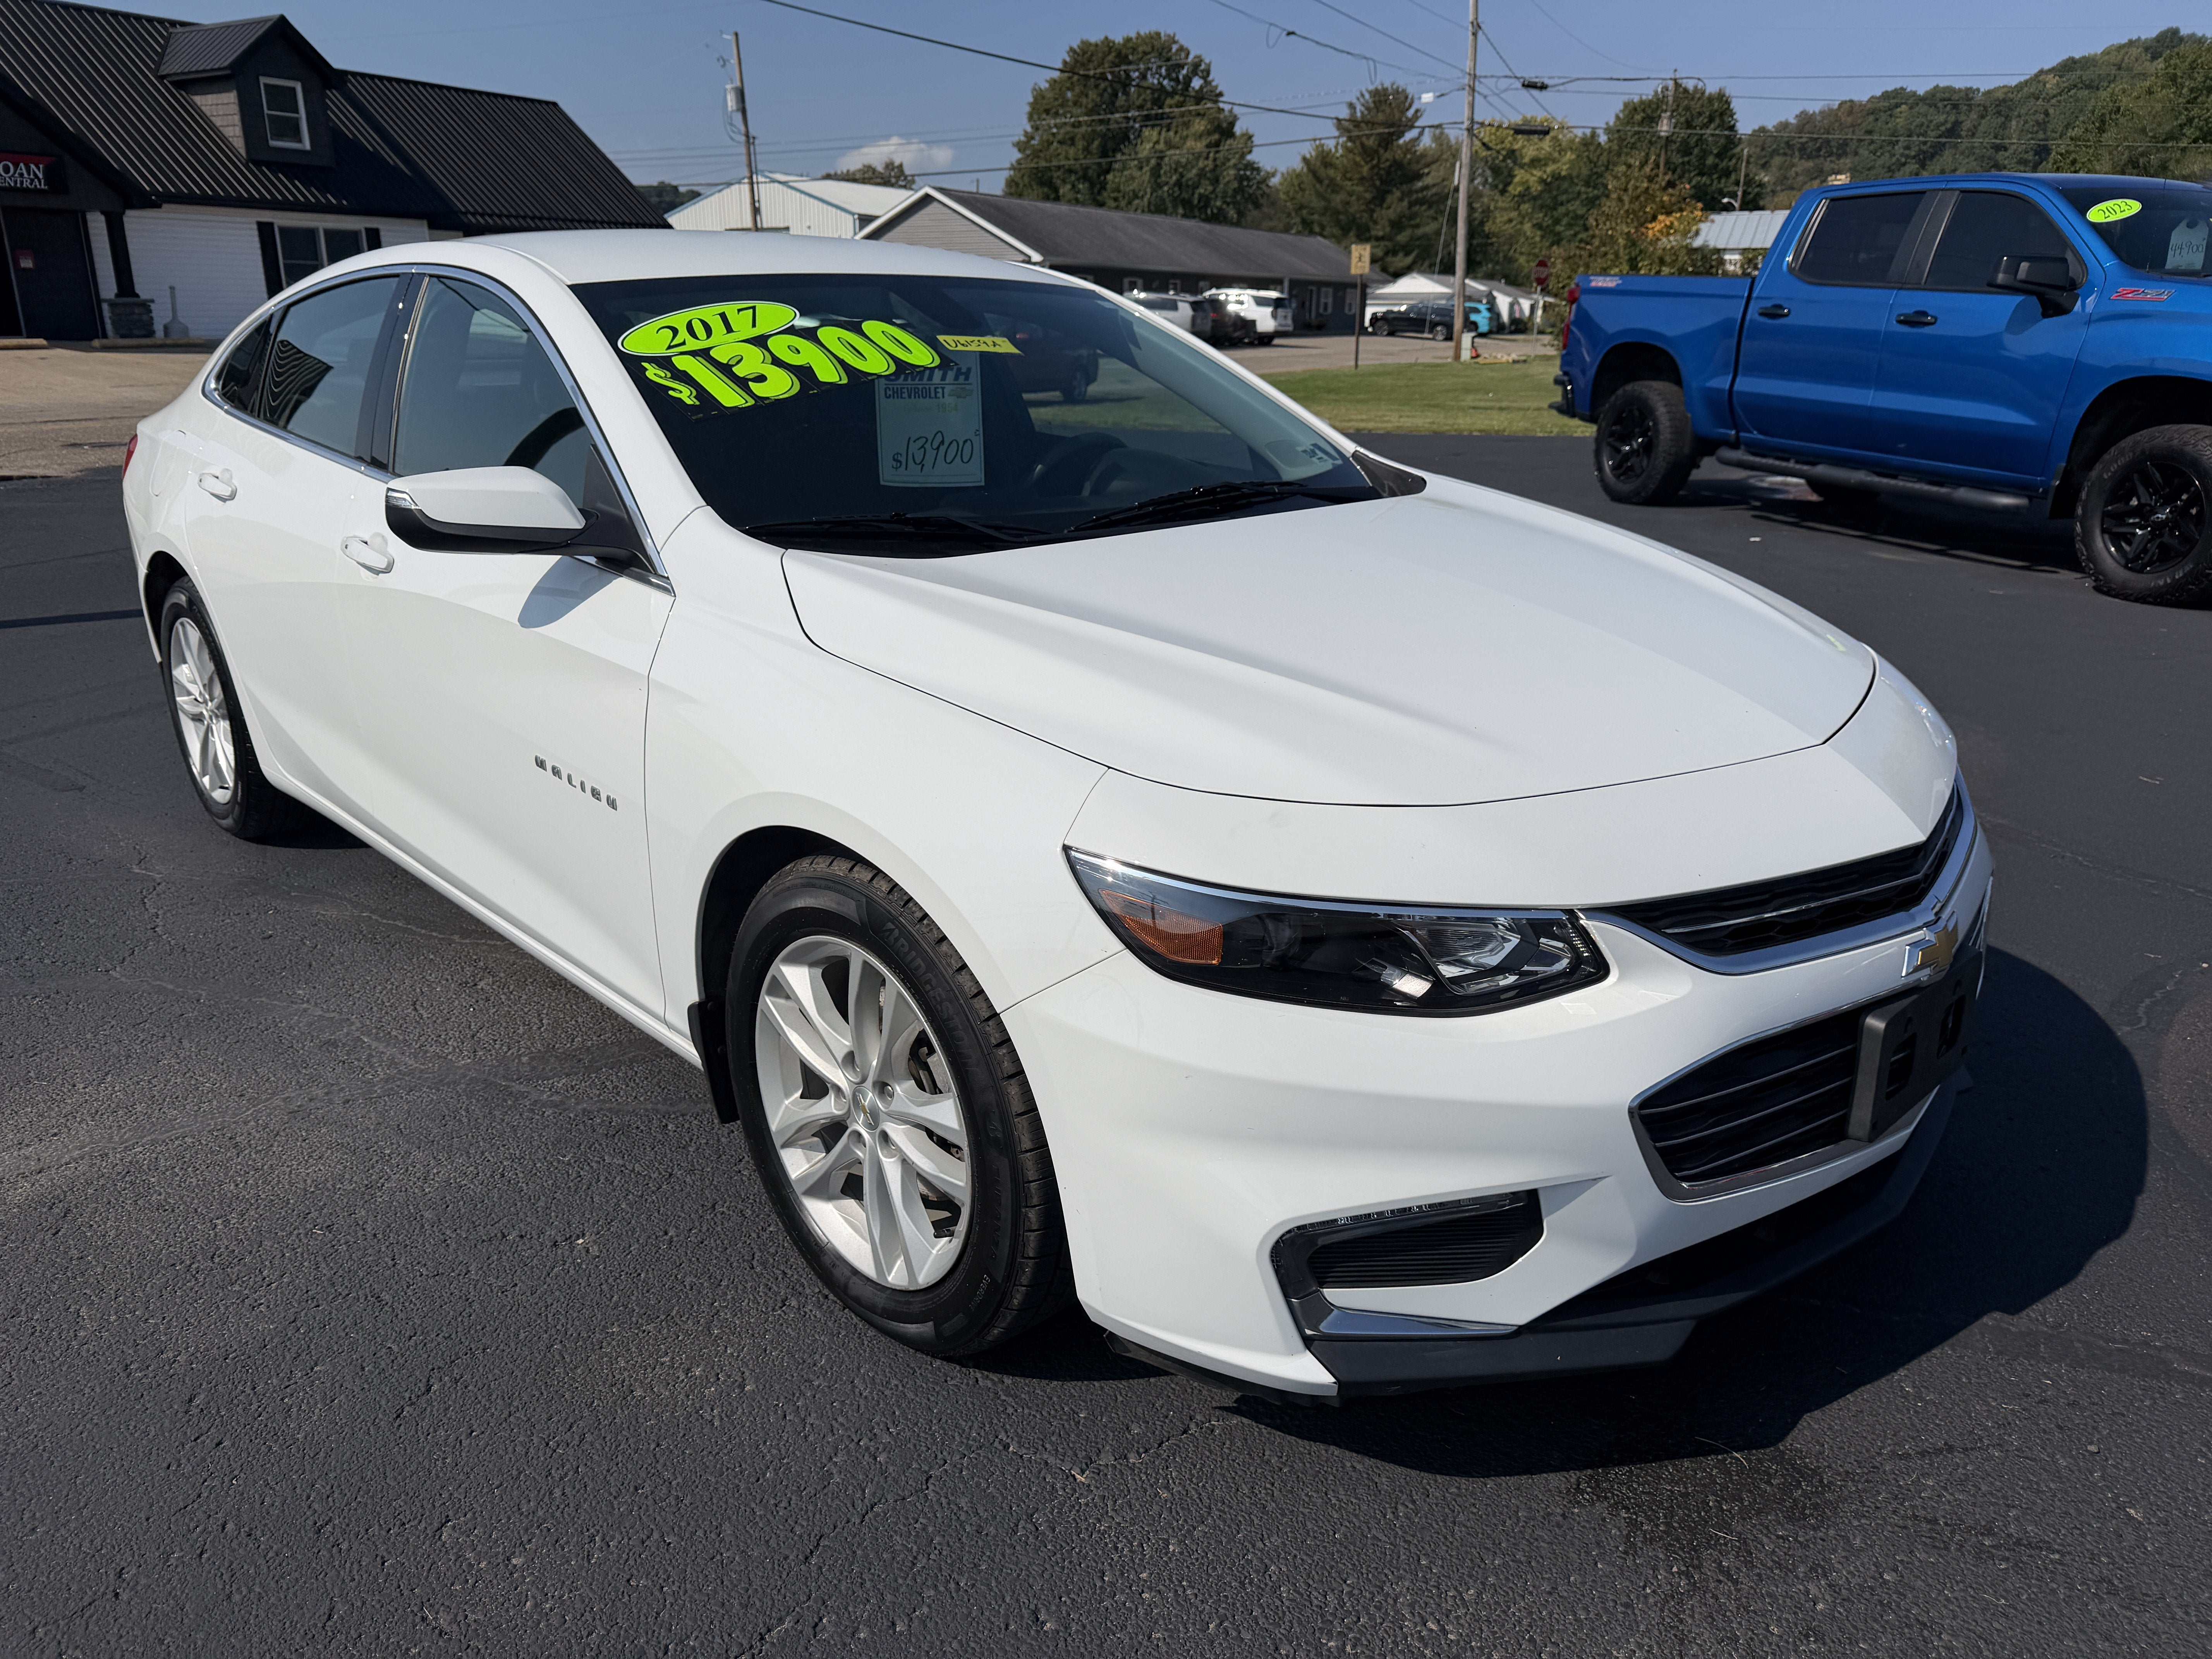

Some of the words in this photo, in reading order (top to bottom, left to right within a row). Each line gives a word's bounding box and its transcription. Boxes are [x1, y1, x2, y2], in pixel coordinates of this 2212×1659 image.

[0, 161, 44, 179] OAN
[0, 176, 47, 189] ENTRAL
[2097, 201, 2132, 219] 2023
[656, 305, 756, 351] 2017
[641, 319, 941, 408] $13900
[884, 386, 946, 399] CHEVROLET
[535, 755, 617, 811] MALIBU
